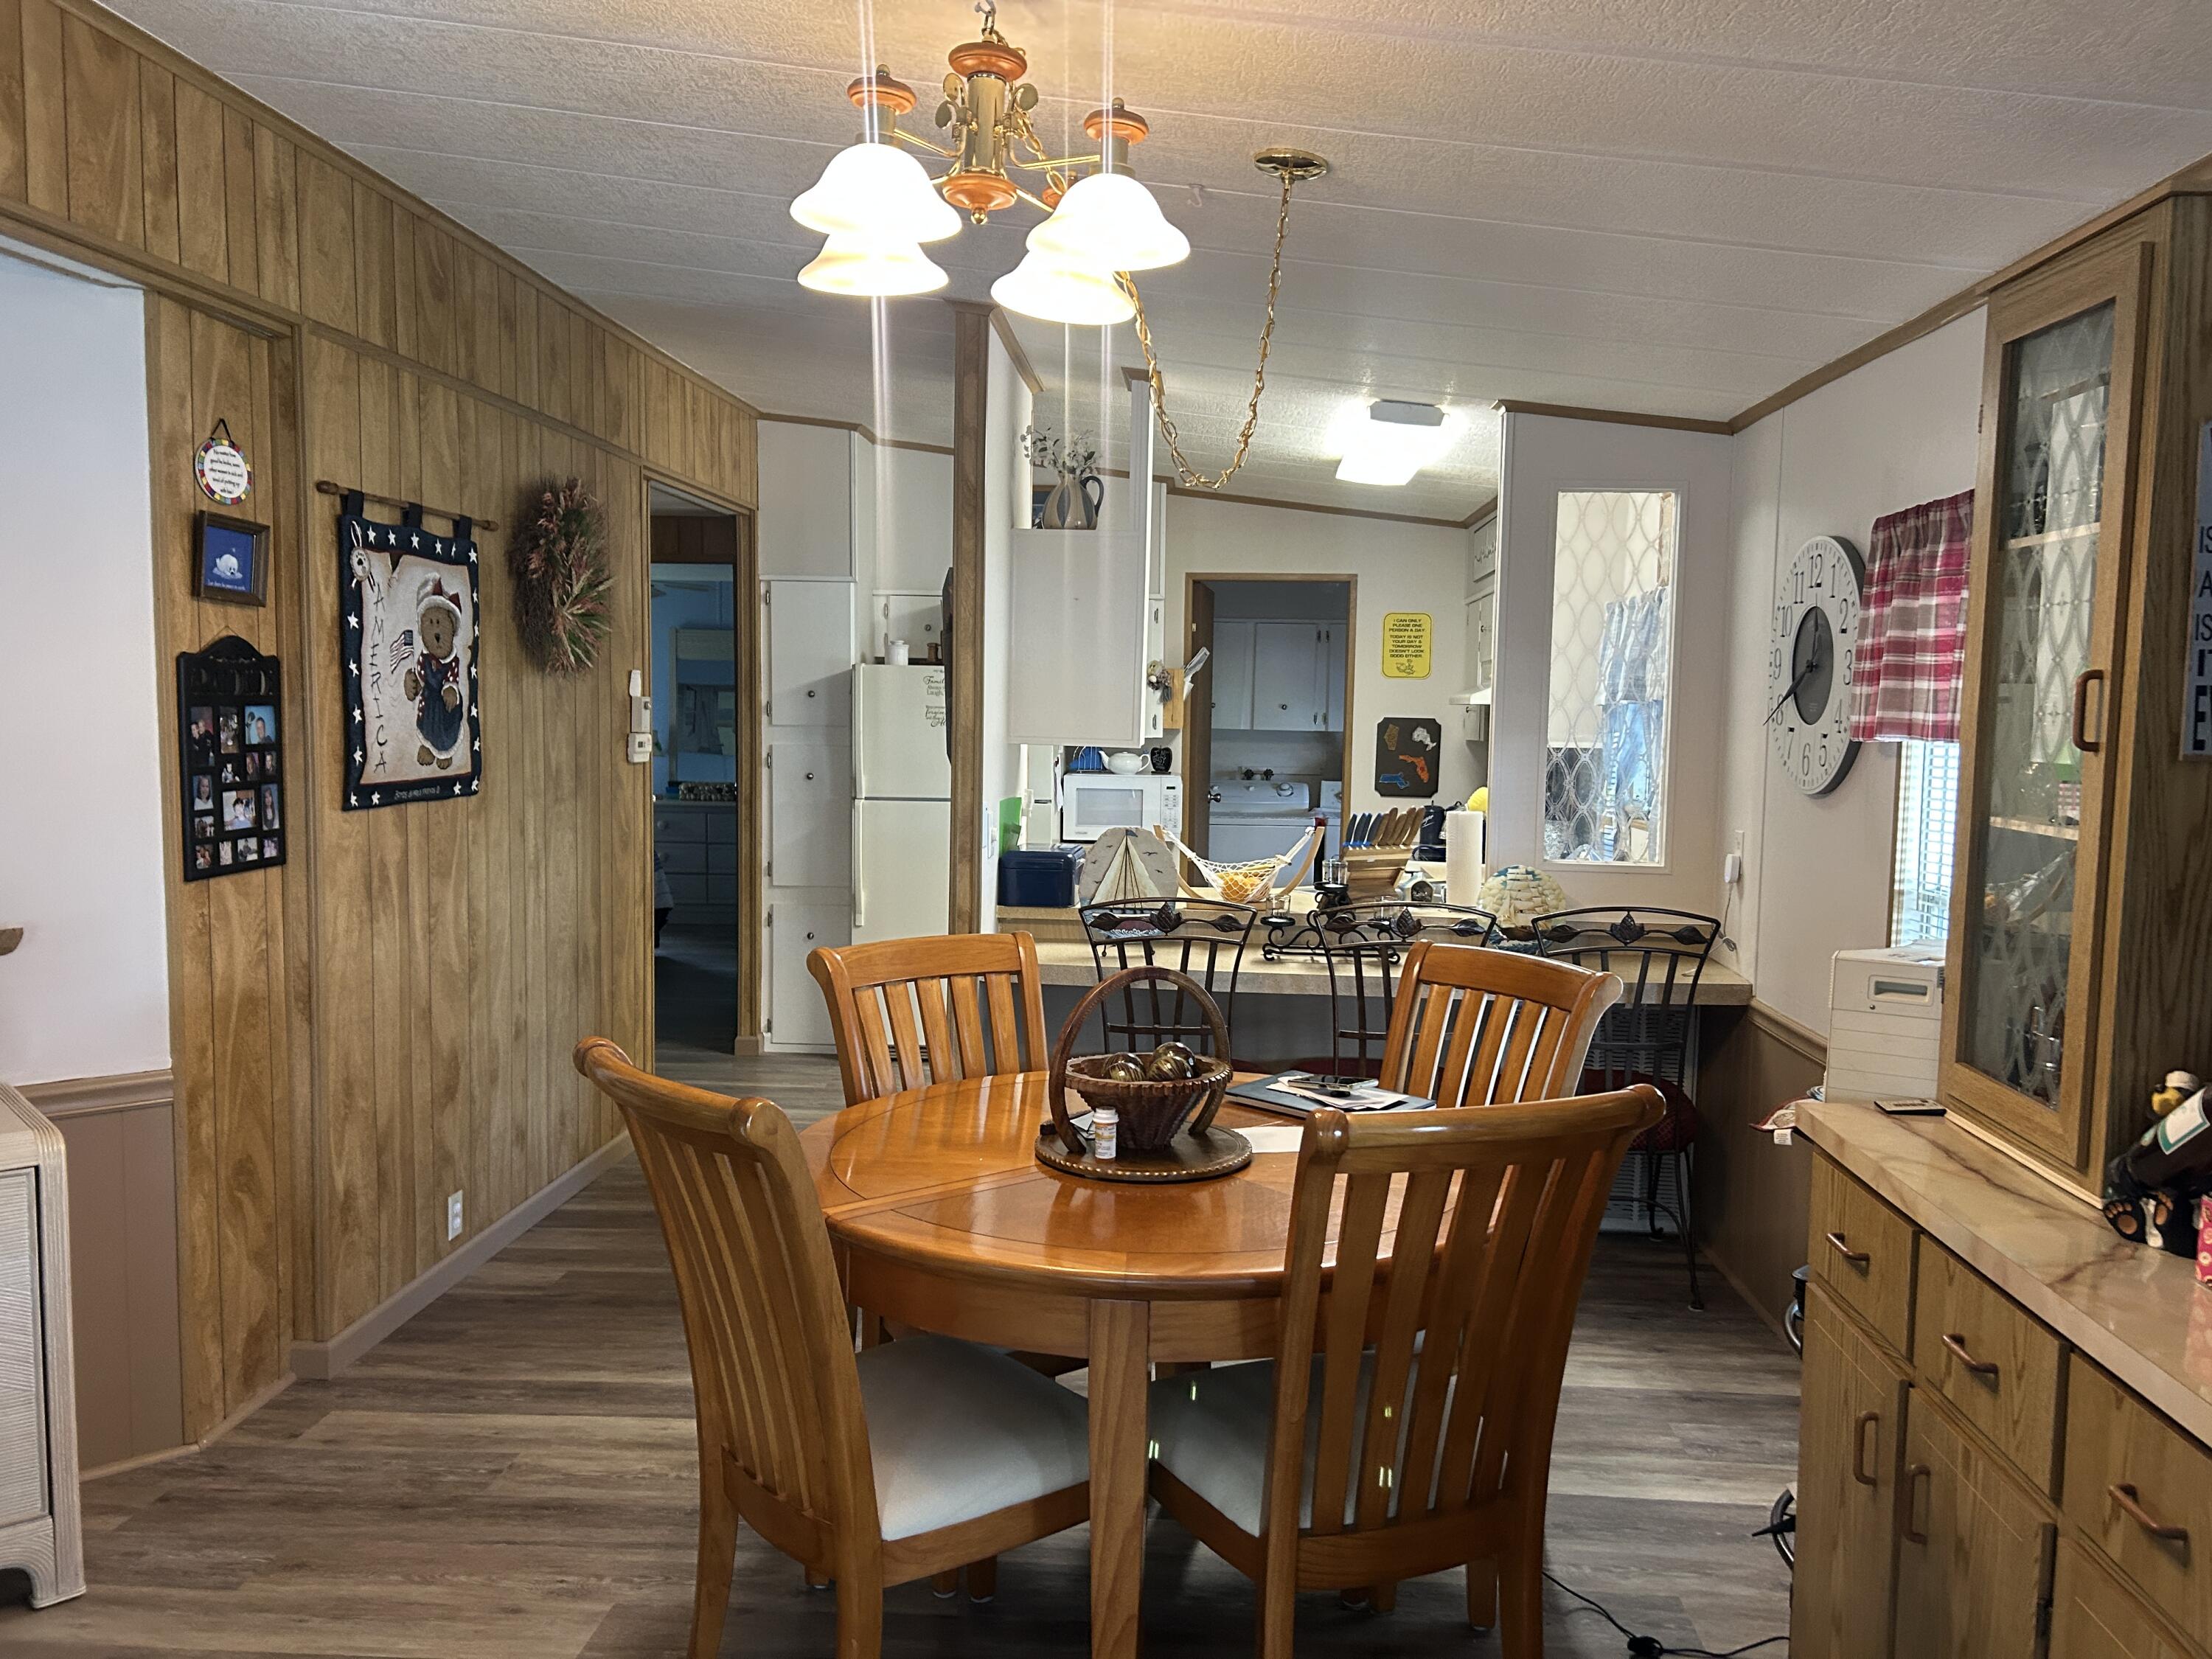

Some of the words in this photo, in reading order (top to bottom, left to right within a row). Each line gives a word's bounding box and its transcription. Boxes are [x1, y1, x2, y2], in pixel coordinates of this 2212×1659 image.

[1794, 571, 1804, 604] 11
[1809, 554, 1823, 588] 12
[1829, 563, 1835, 598] 1
[1781, 605, 1792, 637] 10
[1840, 598, 1848, 633] 2
[369, 582, 388, 773] AMERICA
[1774, 648, 1781, 679] 9
[1843, 650, 1852, 685] 3
[1775, 694, 1784, 726] 8
[1834, 699, 1842, 734] 4
[1787, 727, 1795, 759] 7
[1802, 743, 1810, 776] 6
[1819, 734, 1828, 767] 5
